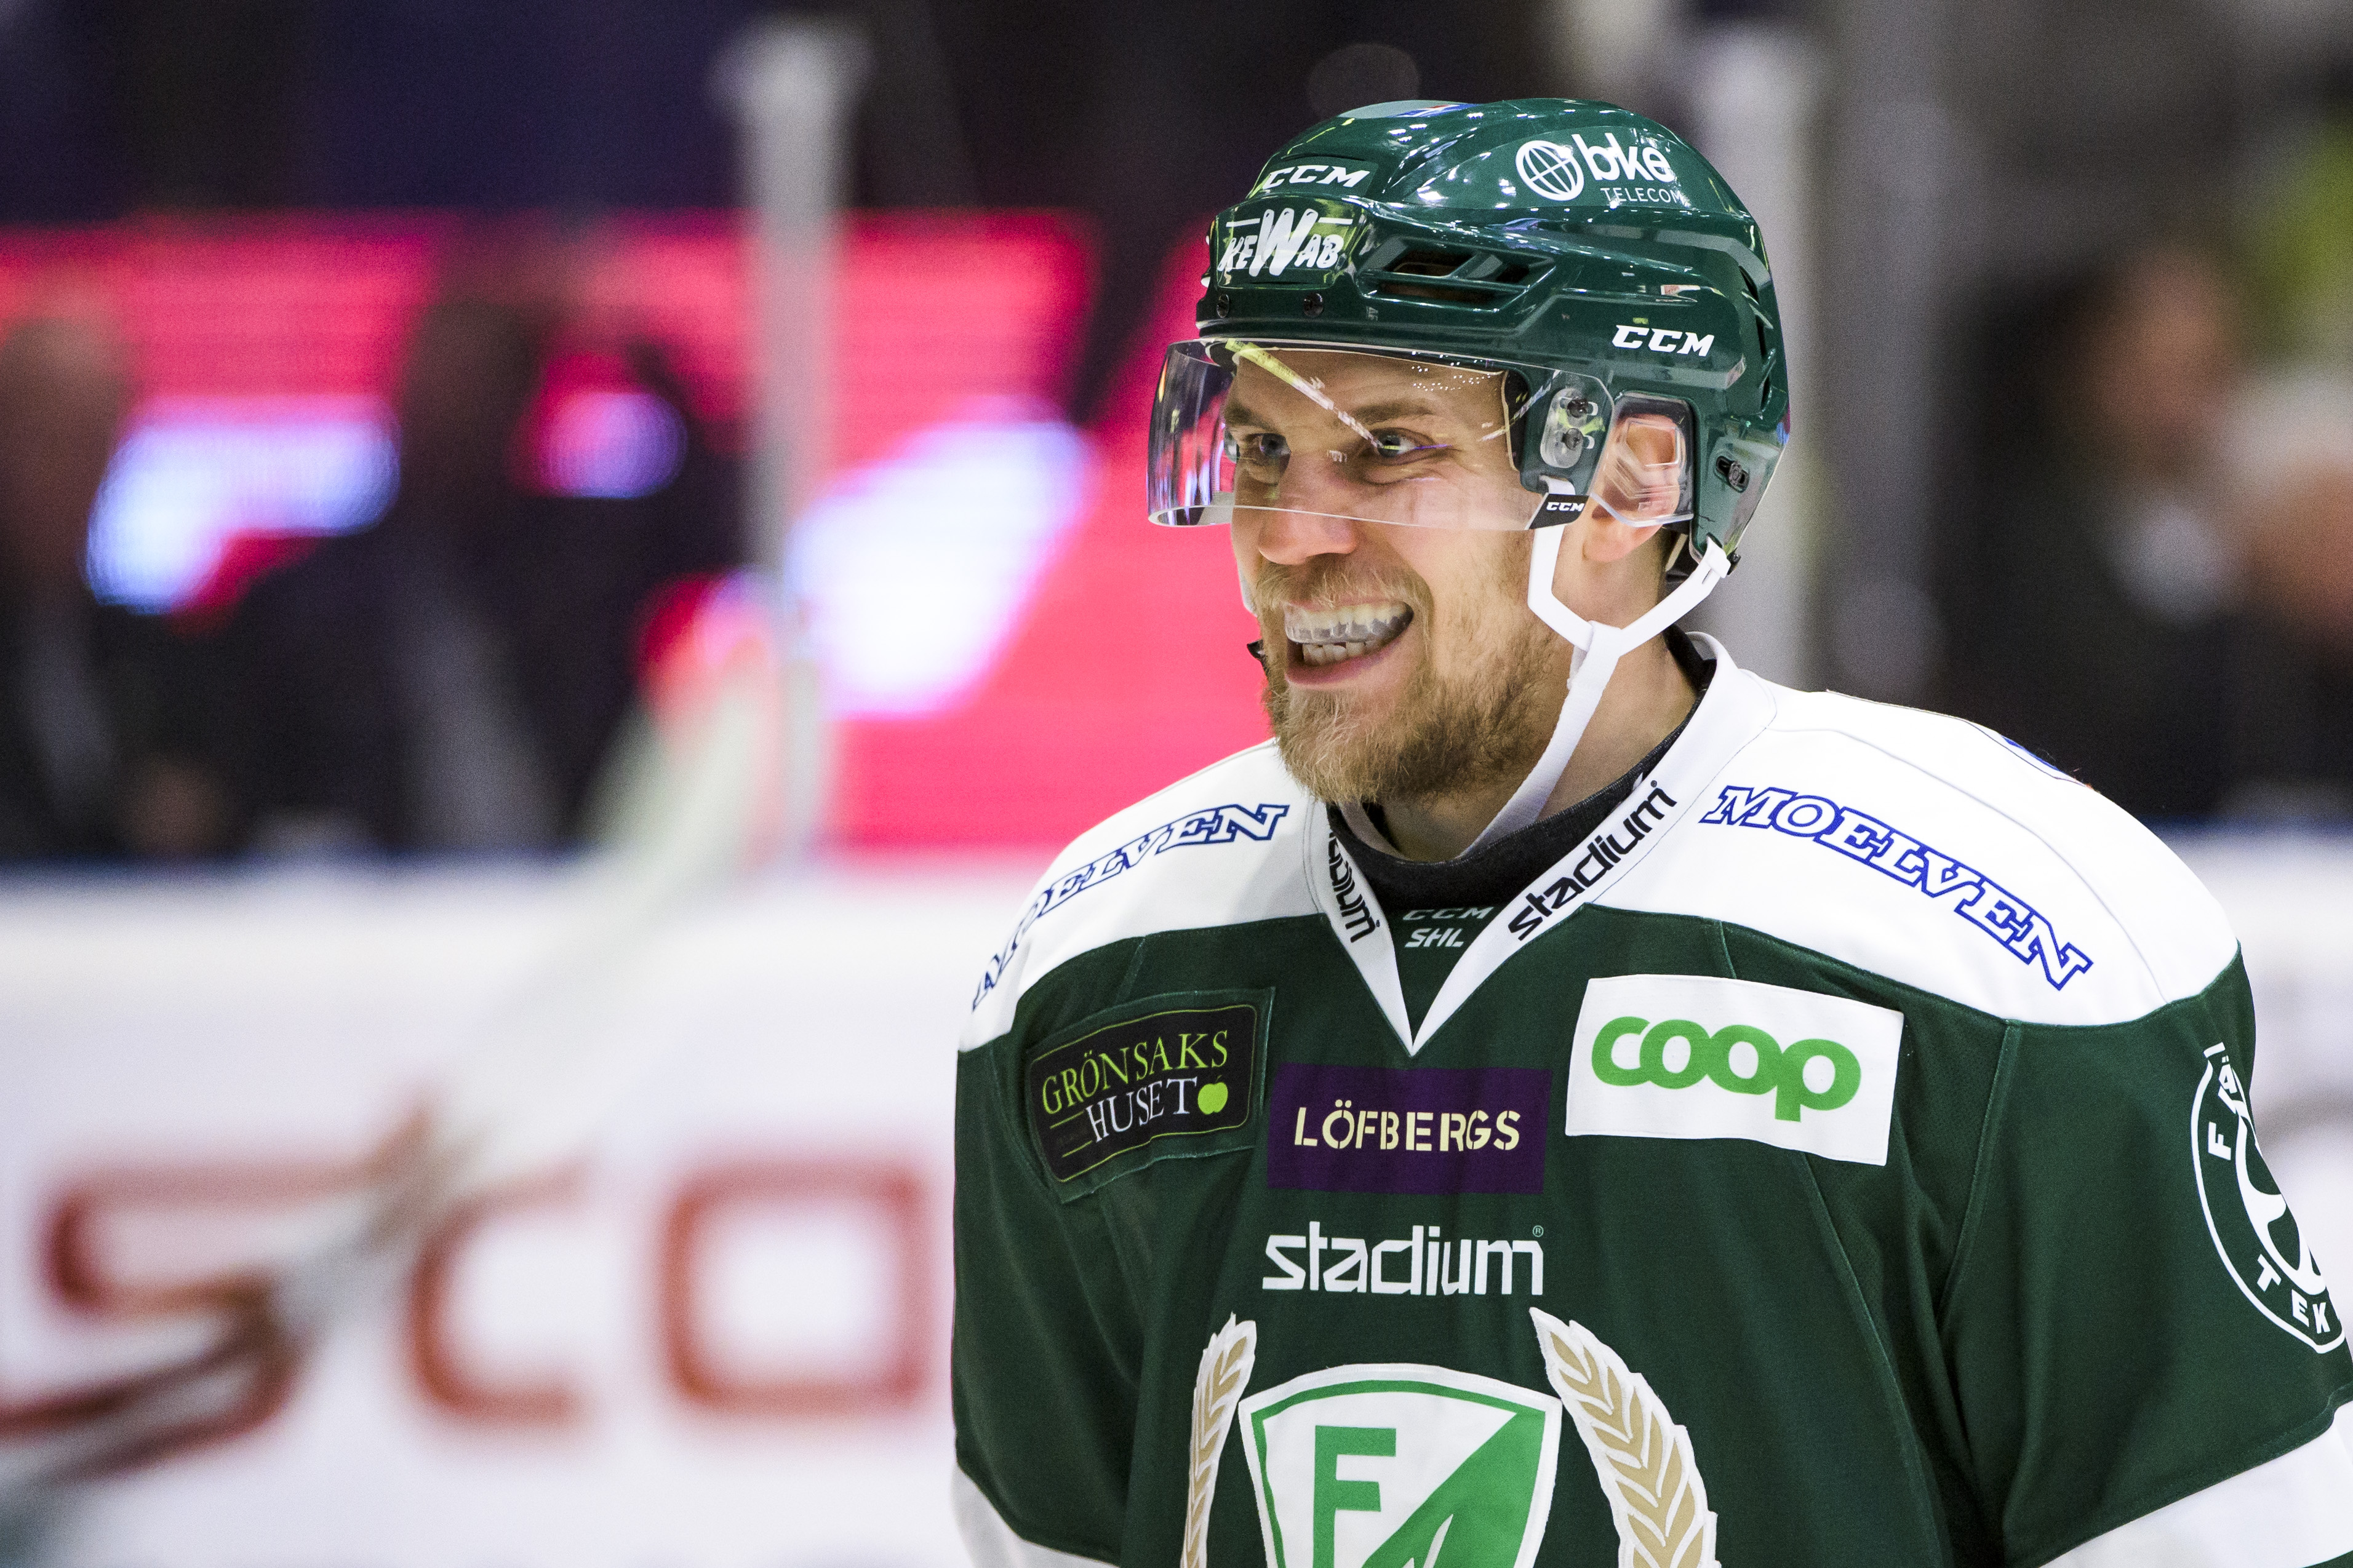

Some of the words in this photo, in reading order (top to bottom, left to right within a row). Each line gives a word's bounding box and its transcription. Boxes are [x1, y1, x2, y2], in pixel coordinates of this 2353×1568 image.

[1260, 165, 1370, 189] CCM
[1572, 133, 1674, 182] bke
[1600, 188, 1690, 203] TELECOM
[1612, 325, 1714, 356] CCM
[1546, 502, 1584, 511] CCM
[1508, 790, 1677, 941] stadium
[1699, 786, 2093, 990] MOELVEN
[1403, 907, 1494, 920] CCM
[1405, 928, 1464, 947] SHL
[1042, 1030, 1228, 1114] GRÖNSAKS
[1591, 1016, 1862, 1122] coop
[1085, 1078, 1198, 1143] HUSET
[1295, 1099, 1520, 1152] LÖFBERGS
[1262, 1221, 1543, 1295] stadium
